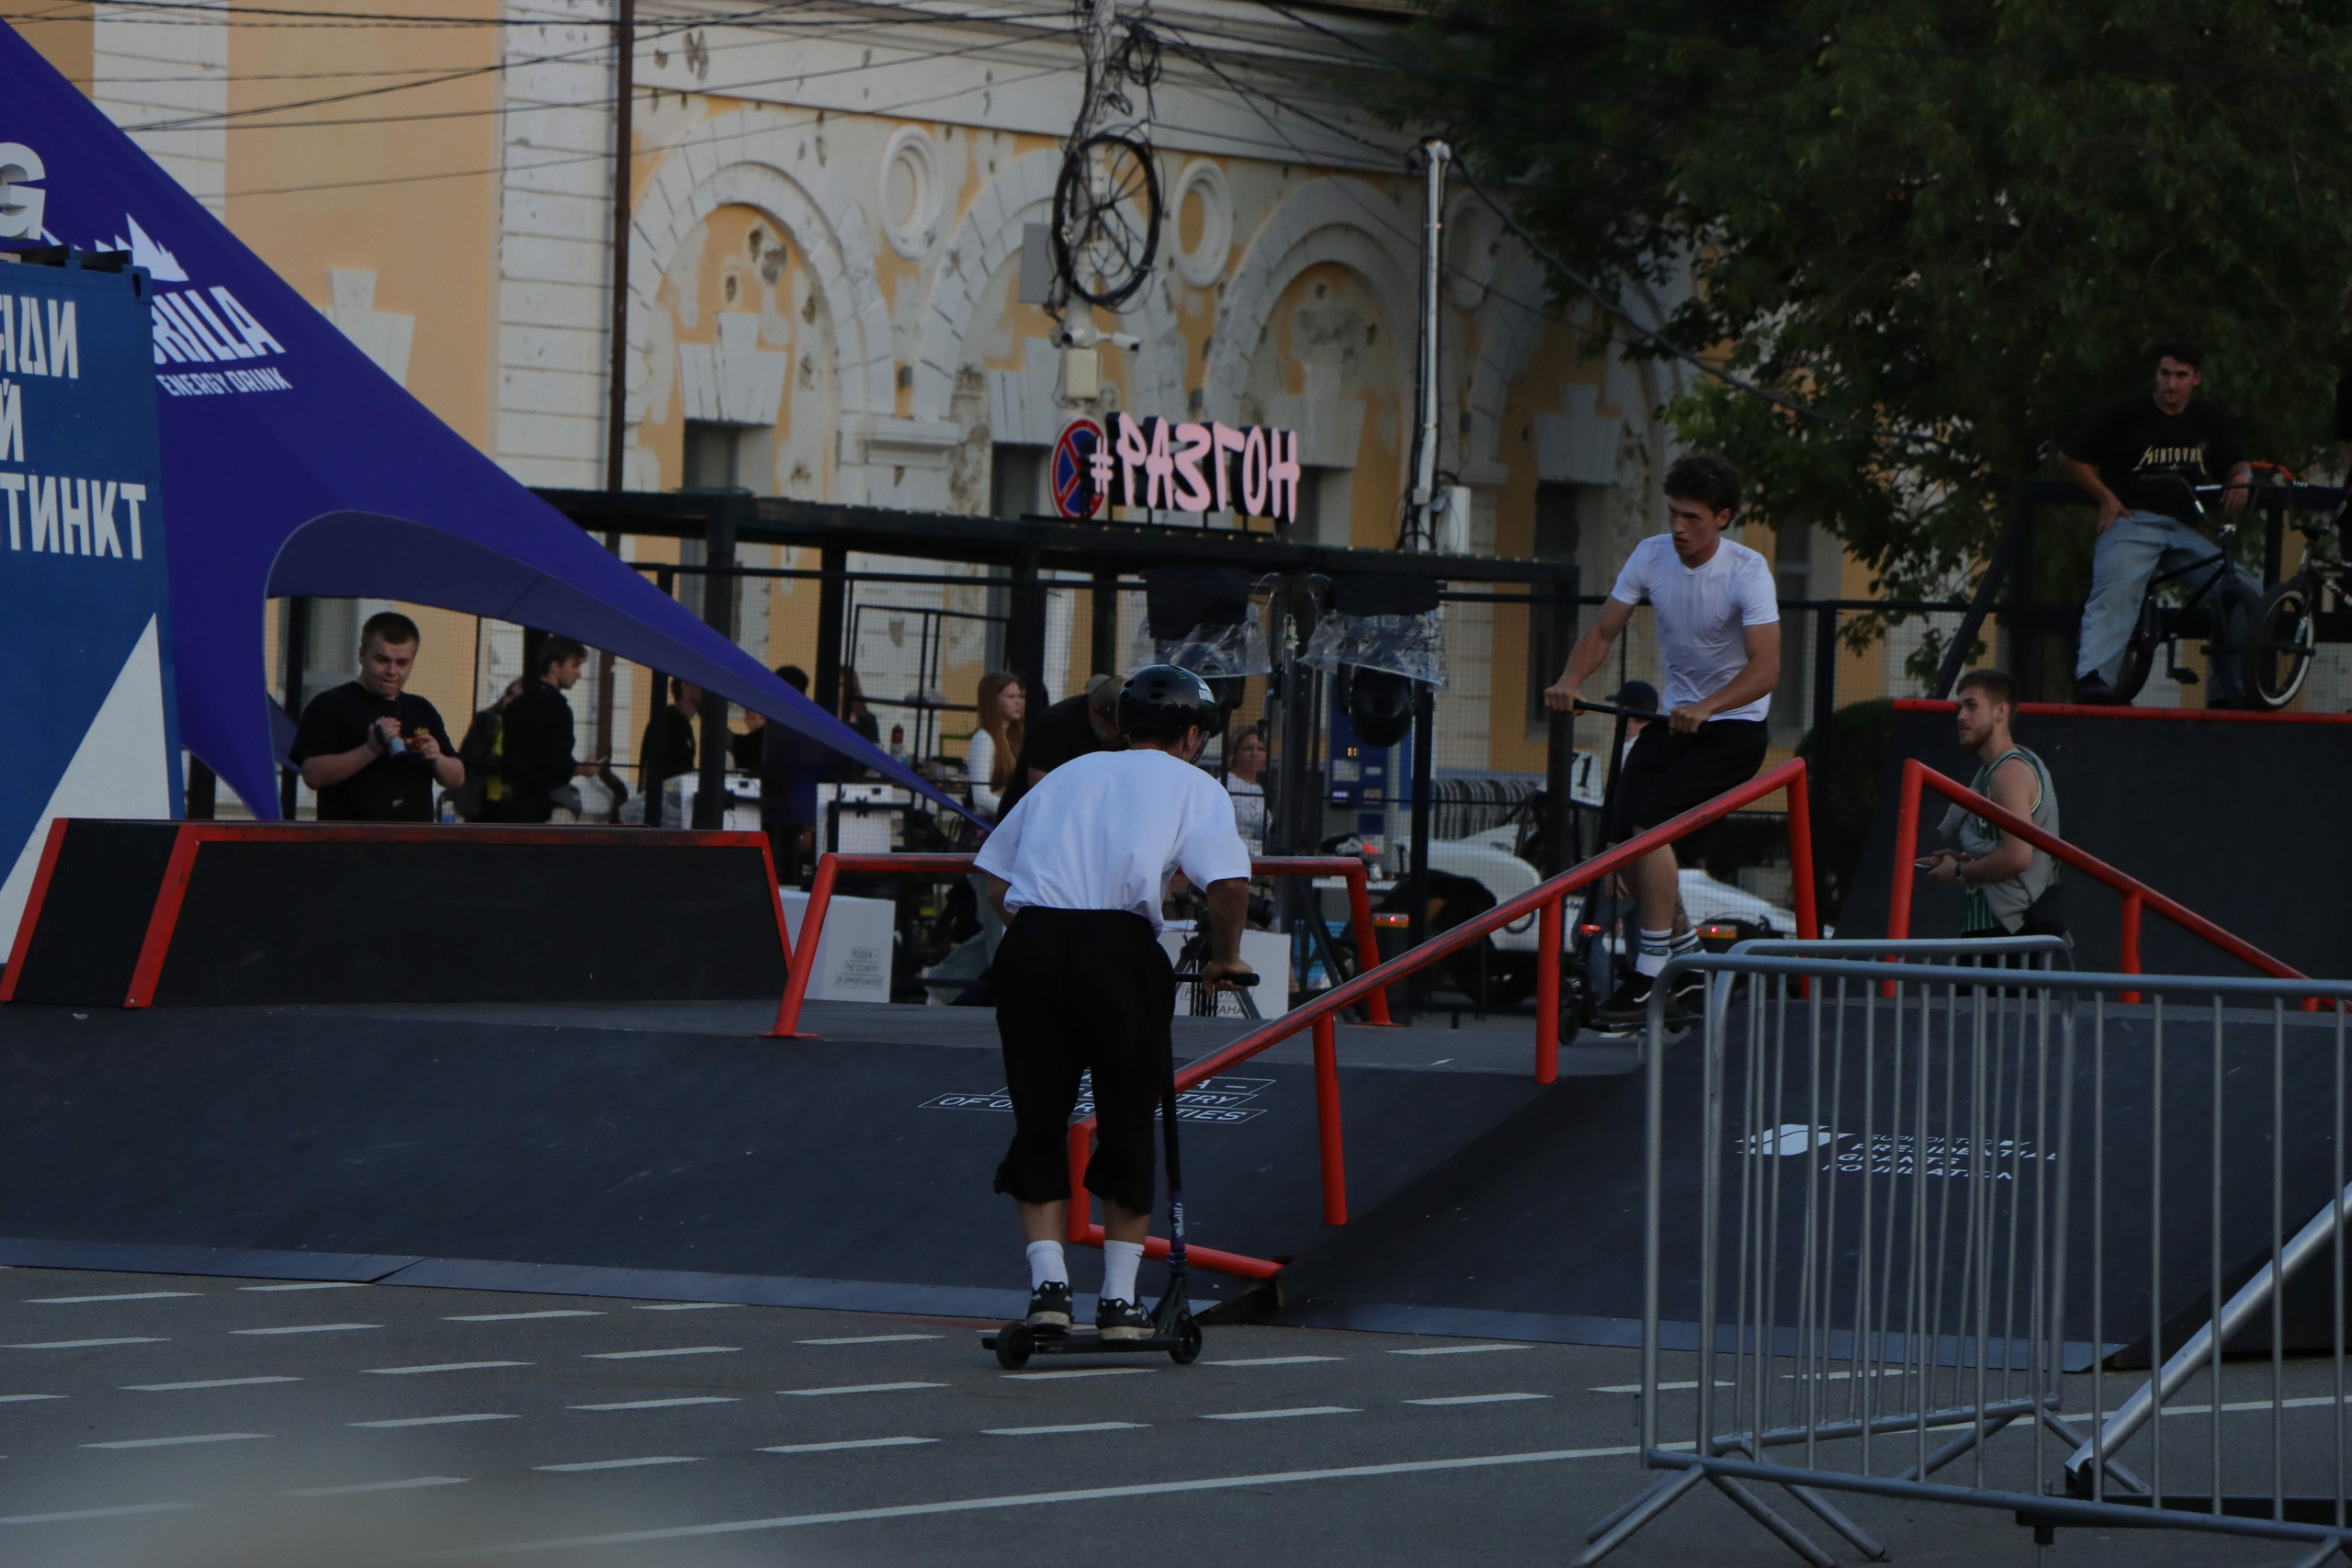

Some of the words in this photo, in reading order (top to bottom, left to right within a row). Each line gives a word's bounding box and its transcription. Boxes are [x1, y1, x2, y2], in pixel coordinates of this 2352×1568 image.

[152, 286, 287, 365] RILLA
[155, 372, 233, 396] ENERGY
[224, 367, 294, 393] DRINK
[939, 1097, 990, 1107] OF
